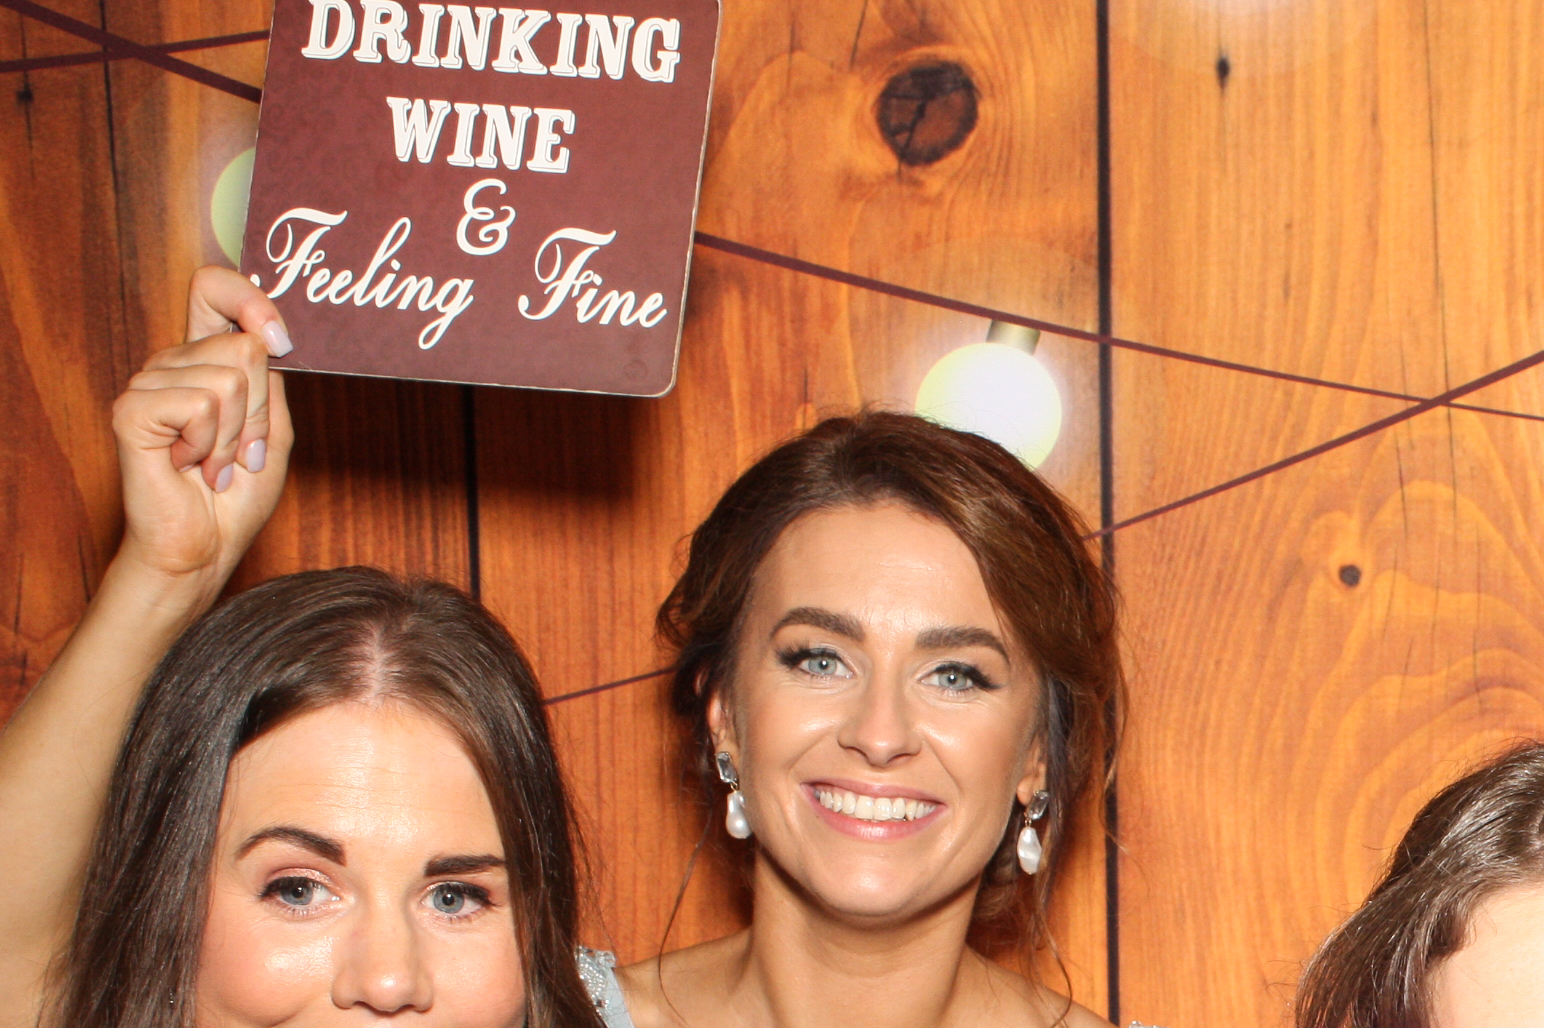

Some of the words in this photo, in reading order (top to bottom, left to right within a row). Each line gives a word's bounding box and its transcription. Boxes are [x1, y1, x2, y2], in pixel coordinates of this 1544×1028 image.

[301, 0, 682, 84] DRINKING
[386, 96, 576, 174] WINE
[456, 178, 516, 256] &
[250, 207, 475, 351] Feeling
[517, 227, 668, 329] Fine
